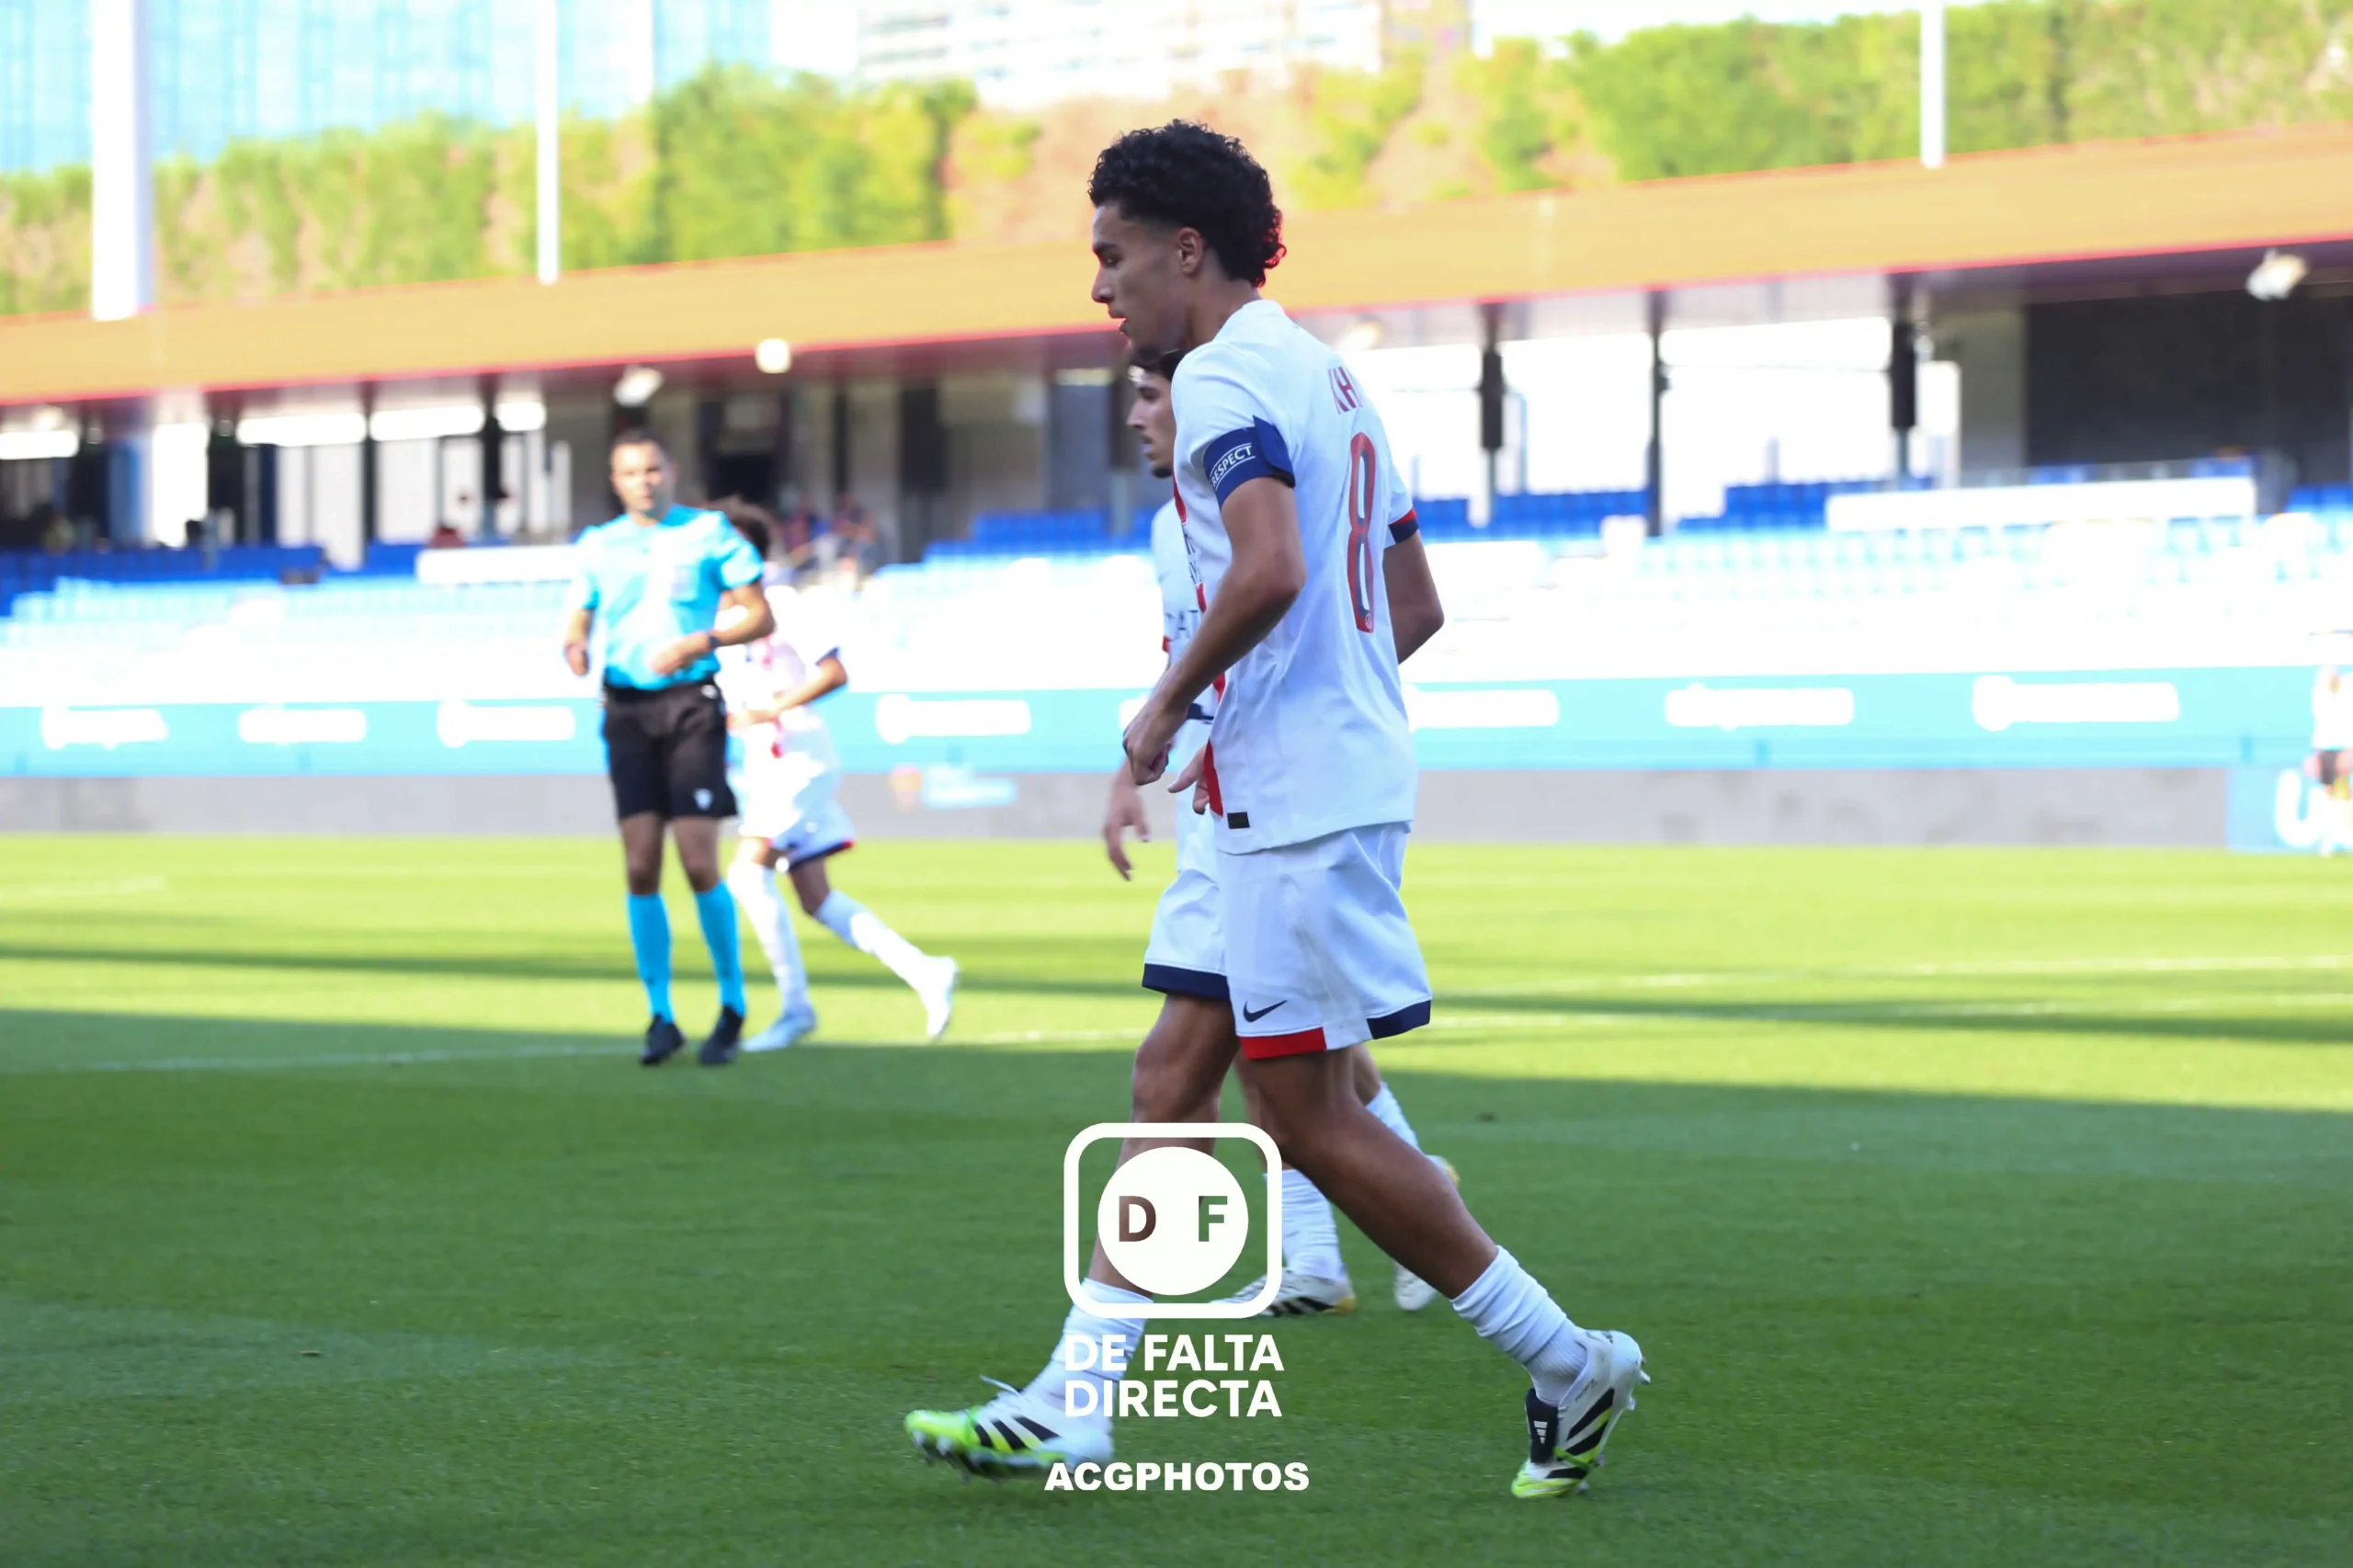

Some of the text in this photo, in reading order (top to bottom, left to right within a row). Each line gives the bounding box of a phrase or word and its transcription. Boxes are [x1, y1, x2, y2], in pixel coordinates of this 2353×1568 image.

[1327, 366, 1363, 415] KH
[1211, 445, 1252, 487] RESPECT
[1347, 431, 1376, 633] 8
